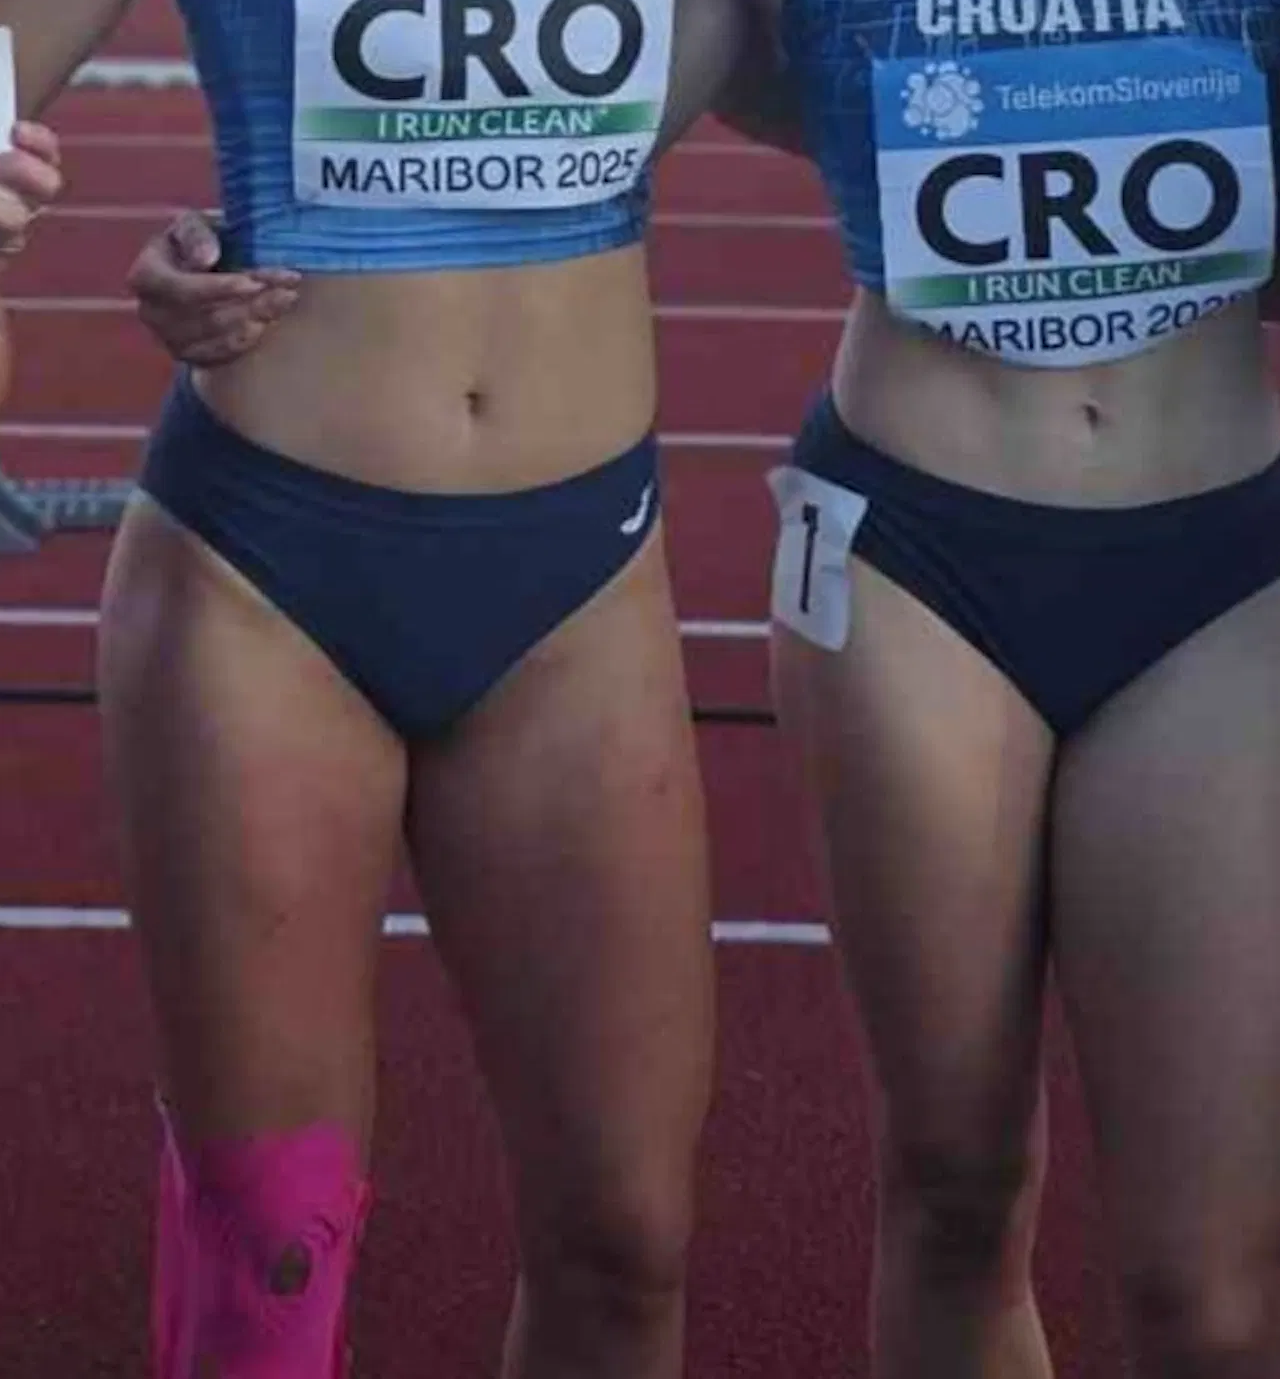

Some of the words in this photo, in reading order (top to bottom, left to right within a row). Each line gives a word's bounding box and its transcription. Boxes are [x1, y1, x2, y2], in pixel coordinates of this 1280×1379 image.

[396, 110, 472, 140] RUN
[479, 107, 594, 137] CLEAN
[320, 152, 546, 194] MARIBOR
[557, 148, 641, 190] 2025
[914, 138, 1242, 268] CRO
[985, 273, 1064, 301] RUN
[1069, 262, 1183, 296] CLEAN
[1146, 293, 1239, 338] 20
[799, 500, 819, 614] 1
